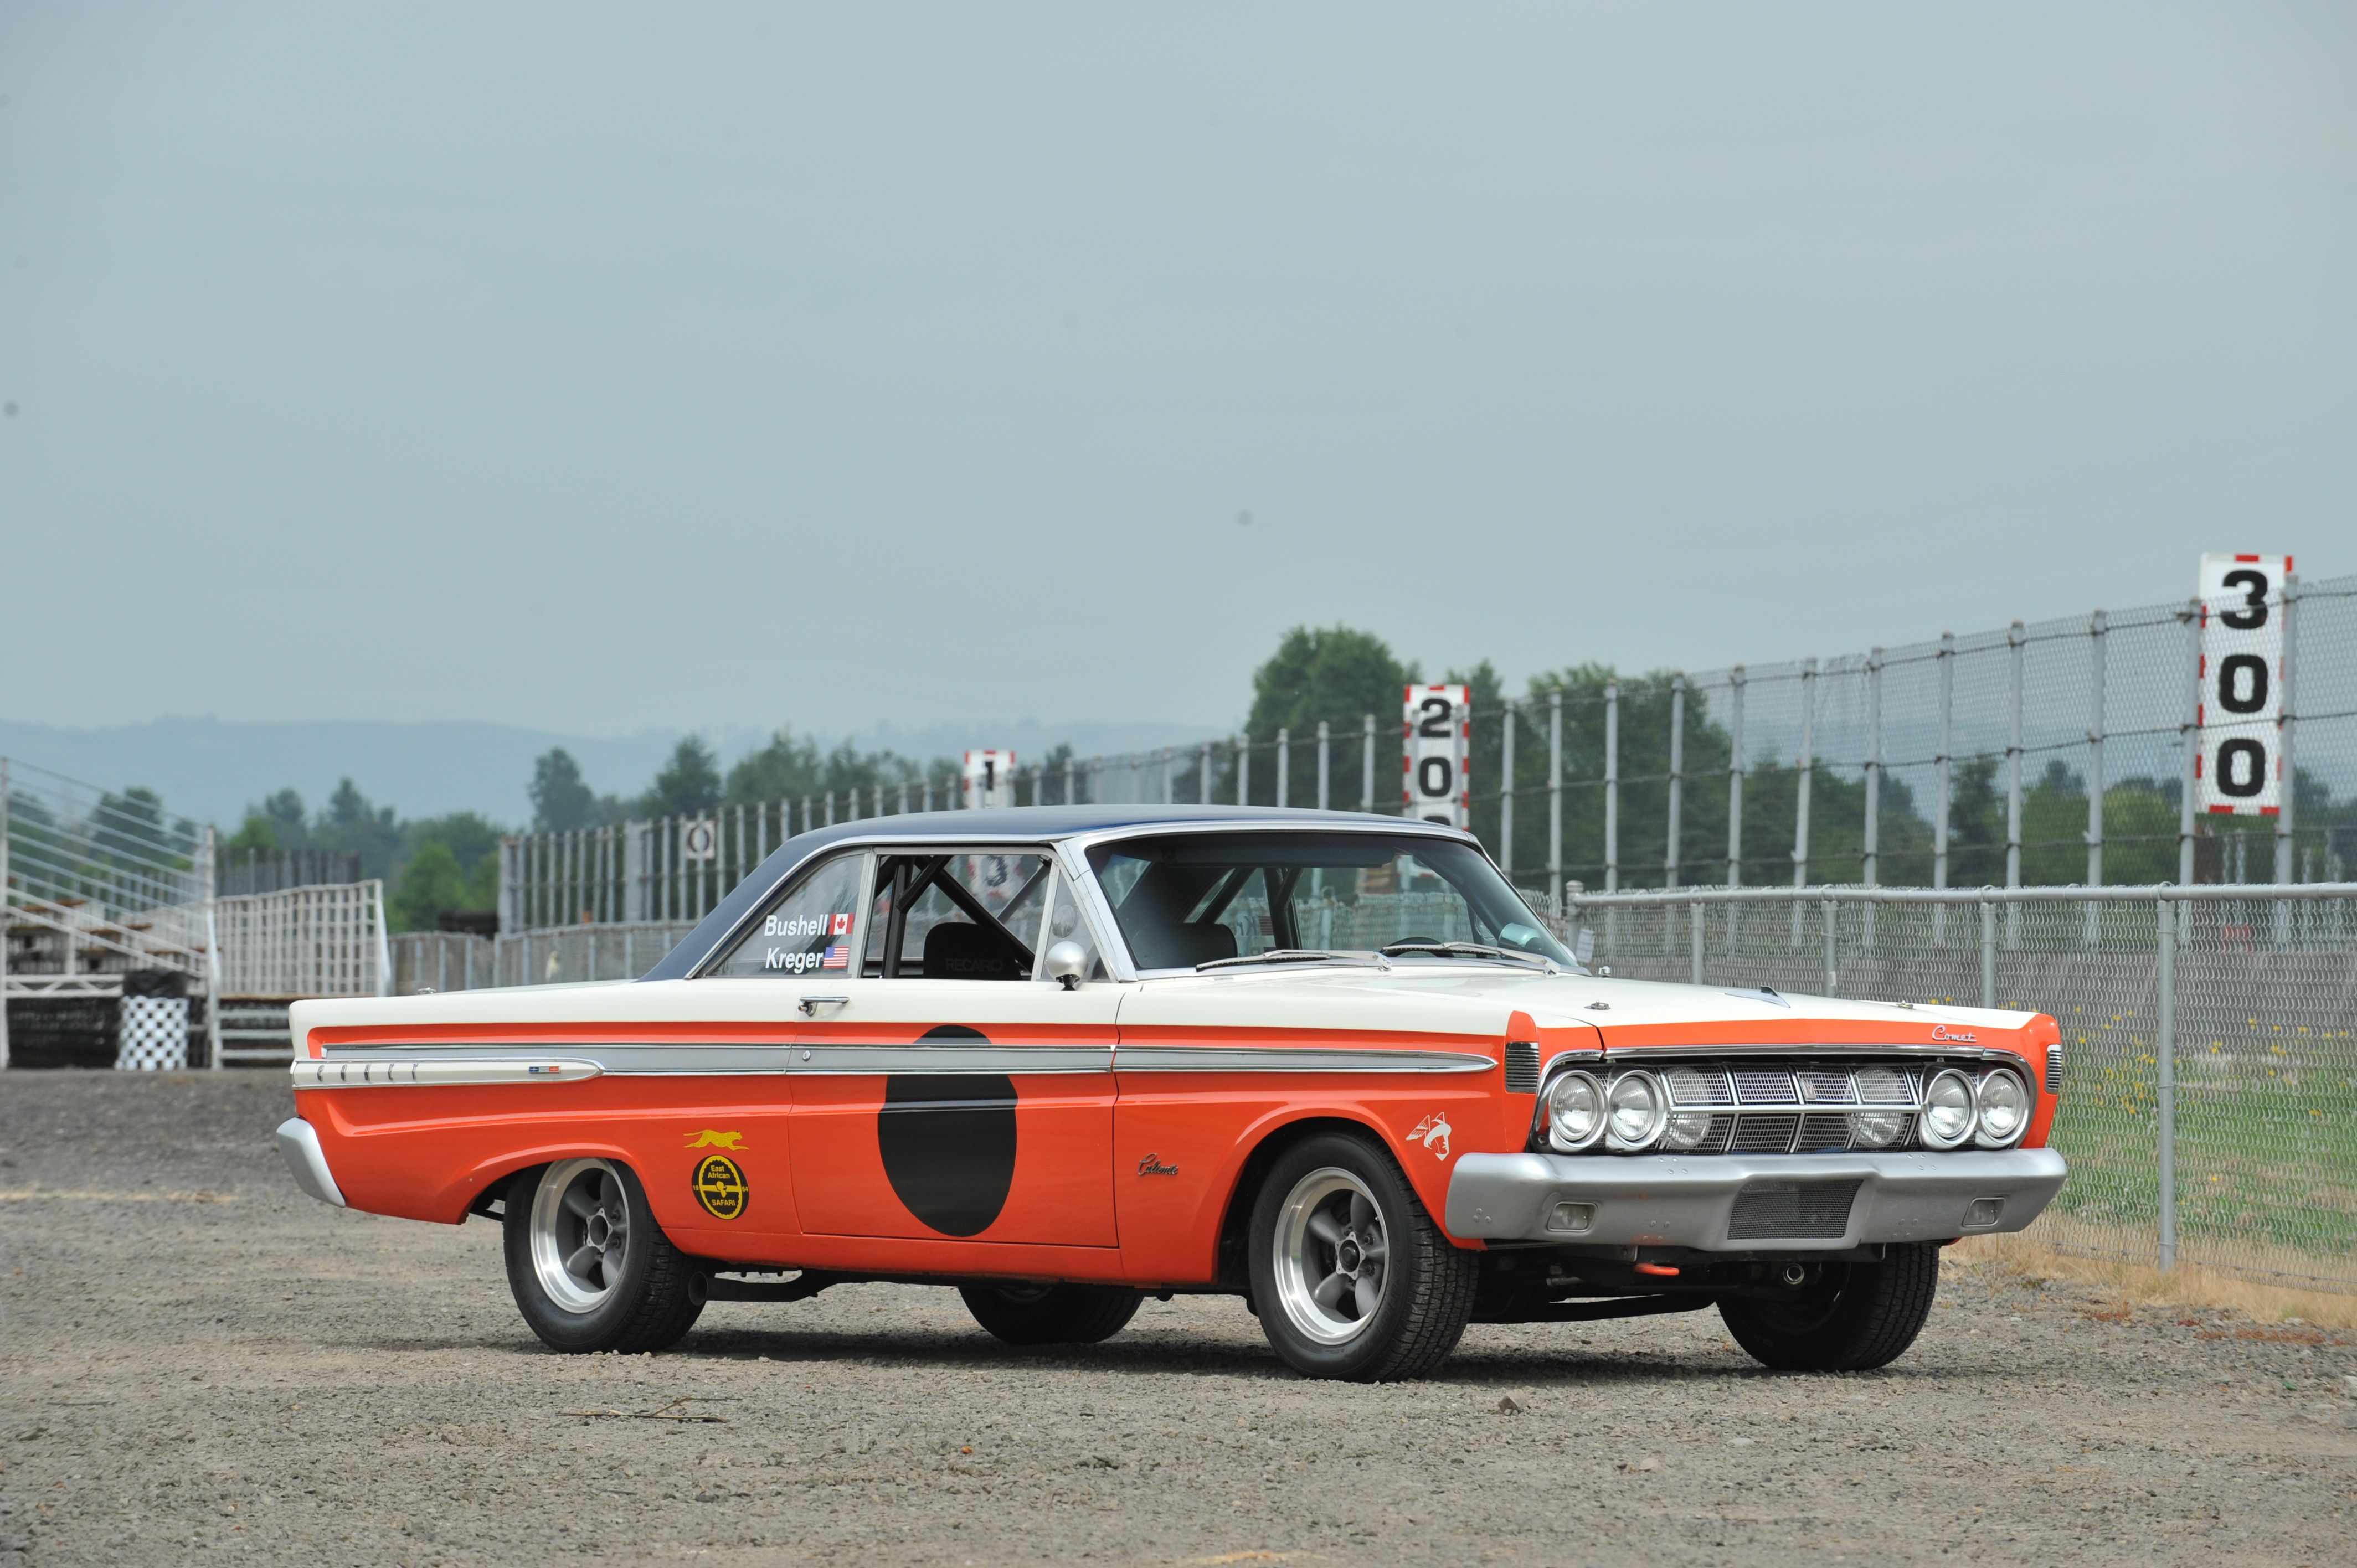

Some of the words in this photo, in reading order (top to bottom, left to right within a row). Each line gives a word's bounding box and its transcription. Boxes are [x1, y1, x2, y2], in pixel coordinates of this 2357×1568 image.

[2217, 570, 2269, 797] 300
[1419, 698, 1452, 826] 20
[764, 914, 829, 936] Bushell
[765, 947, 824, 974] Kreger
[945, 958, 1004, 972] RECARO
[1932, 1024, 1977, 1043] Comet
[1138, 1152, 1179, 1177] Caliente
